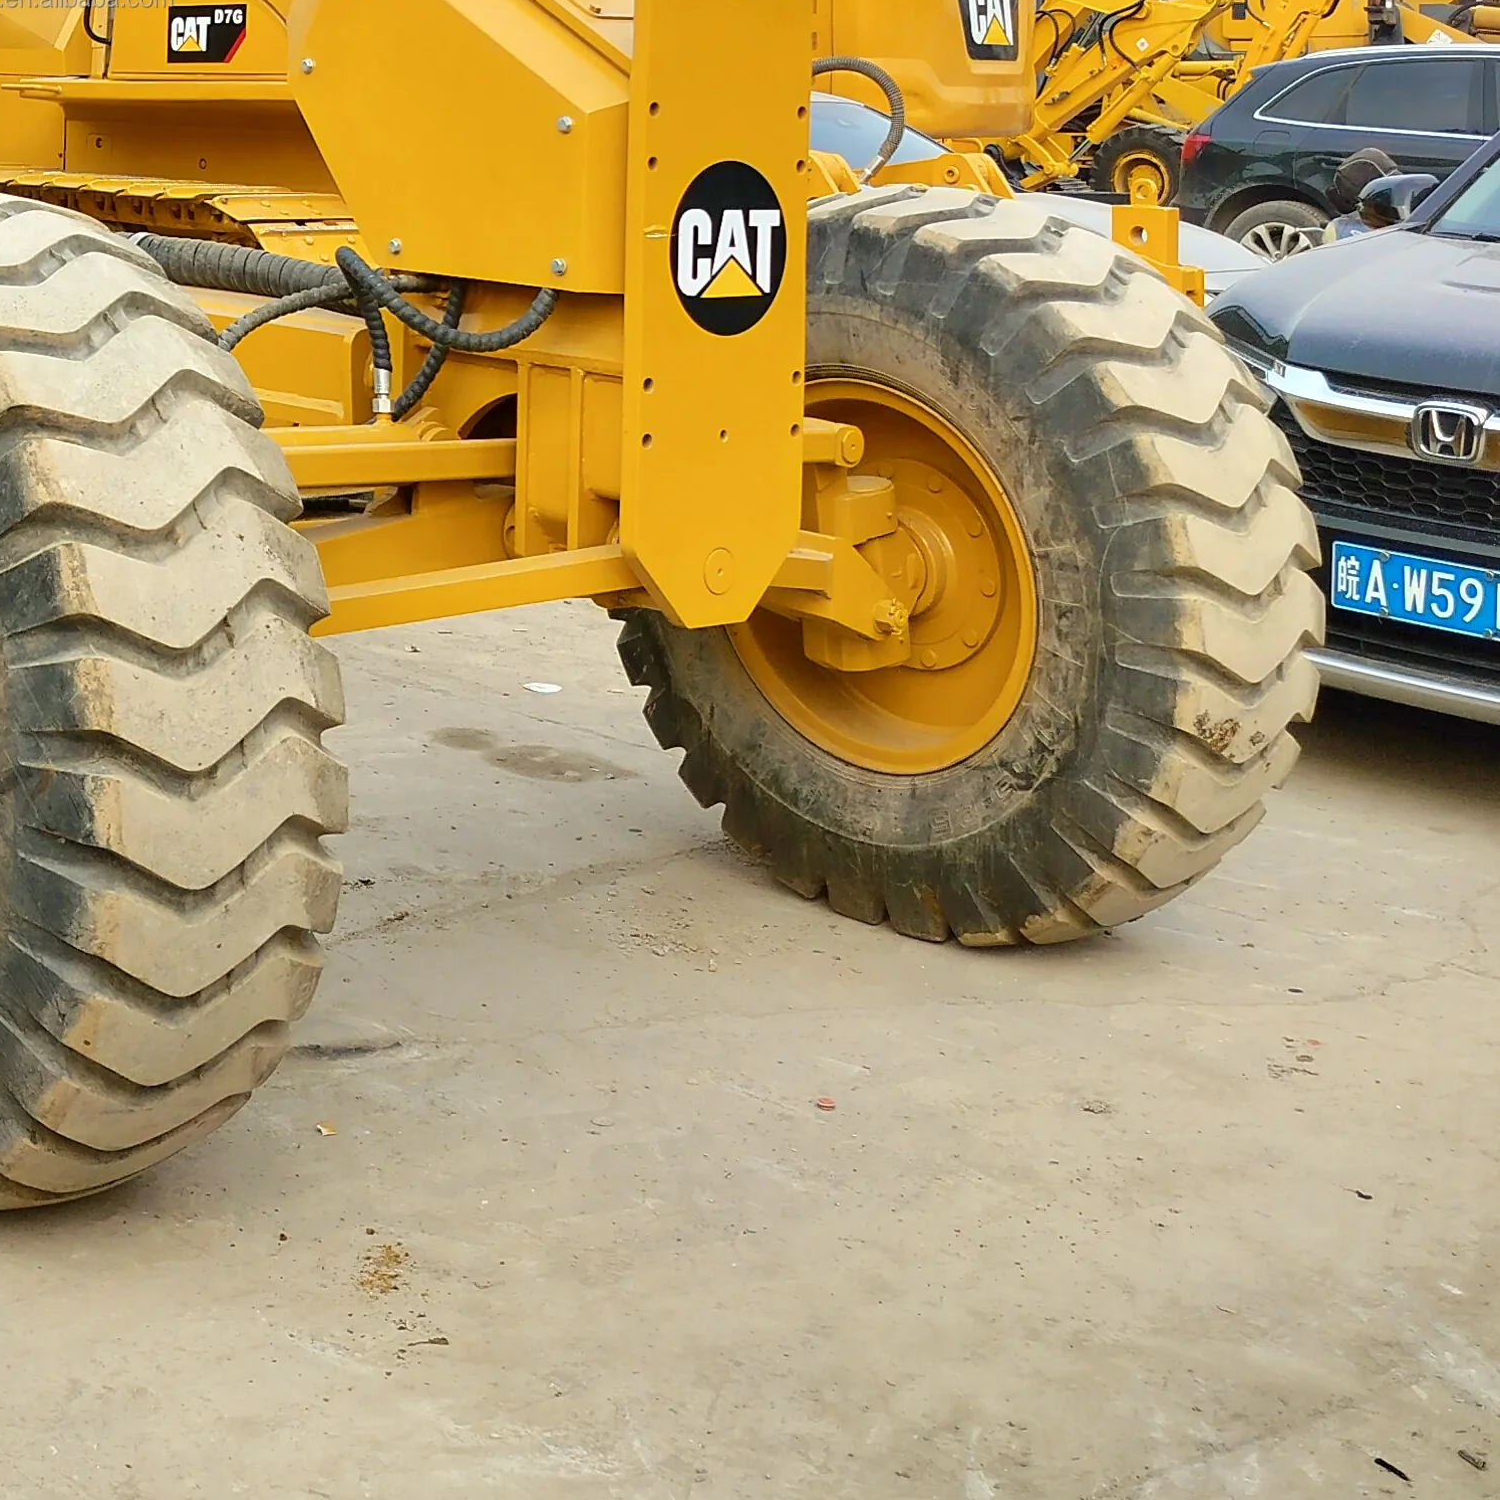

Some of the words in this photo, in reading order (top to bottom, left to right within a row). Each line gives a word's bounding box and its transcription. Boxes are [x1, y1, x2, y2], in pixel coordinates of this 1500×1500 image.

[171, 16, 211, 52] CAT
[214, 9, 243, 24] D7G
[677, 208, 781, 297] CAT
[1337, 555, 1500, 630] 皖A·W59
